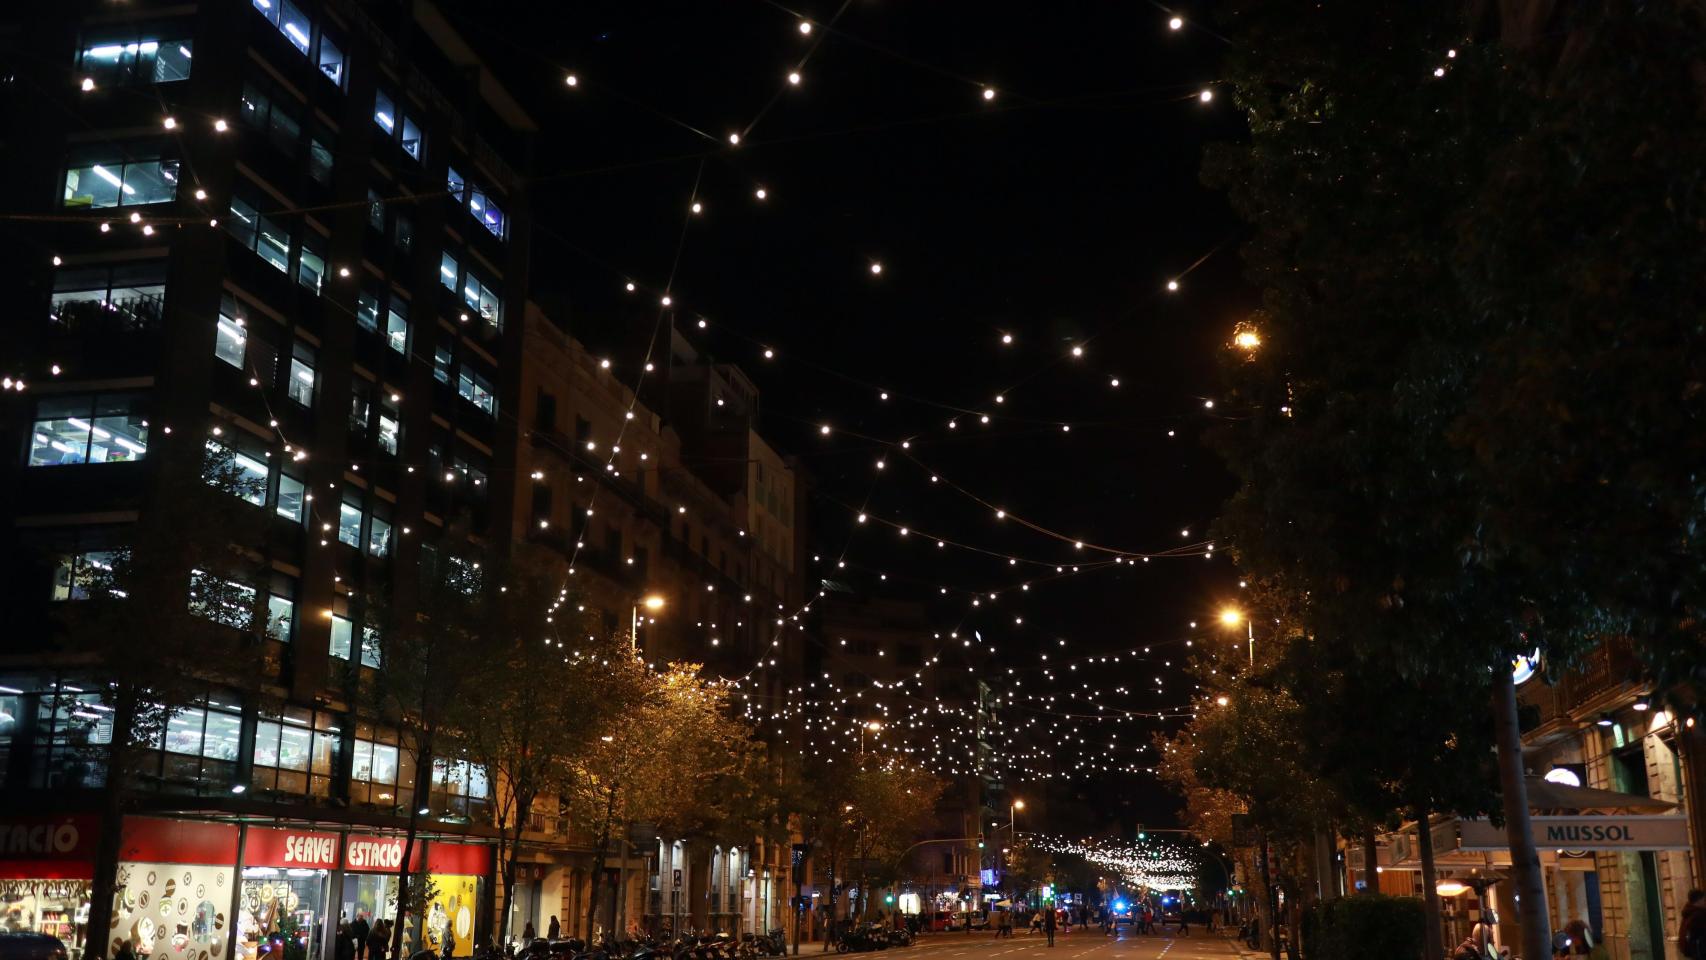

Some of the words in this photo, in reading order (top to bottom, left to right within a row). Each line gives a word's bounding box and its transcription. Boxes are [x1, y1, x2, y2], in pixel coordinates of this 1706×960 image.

[1547, 825, 1634, 841] MUSSOL
[284, 835, 336, 864] SERVEI
[348, 840, 401, 868] ESTACIÓ
